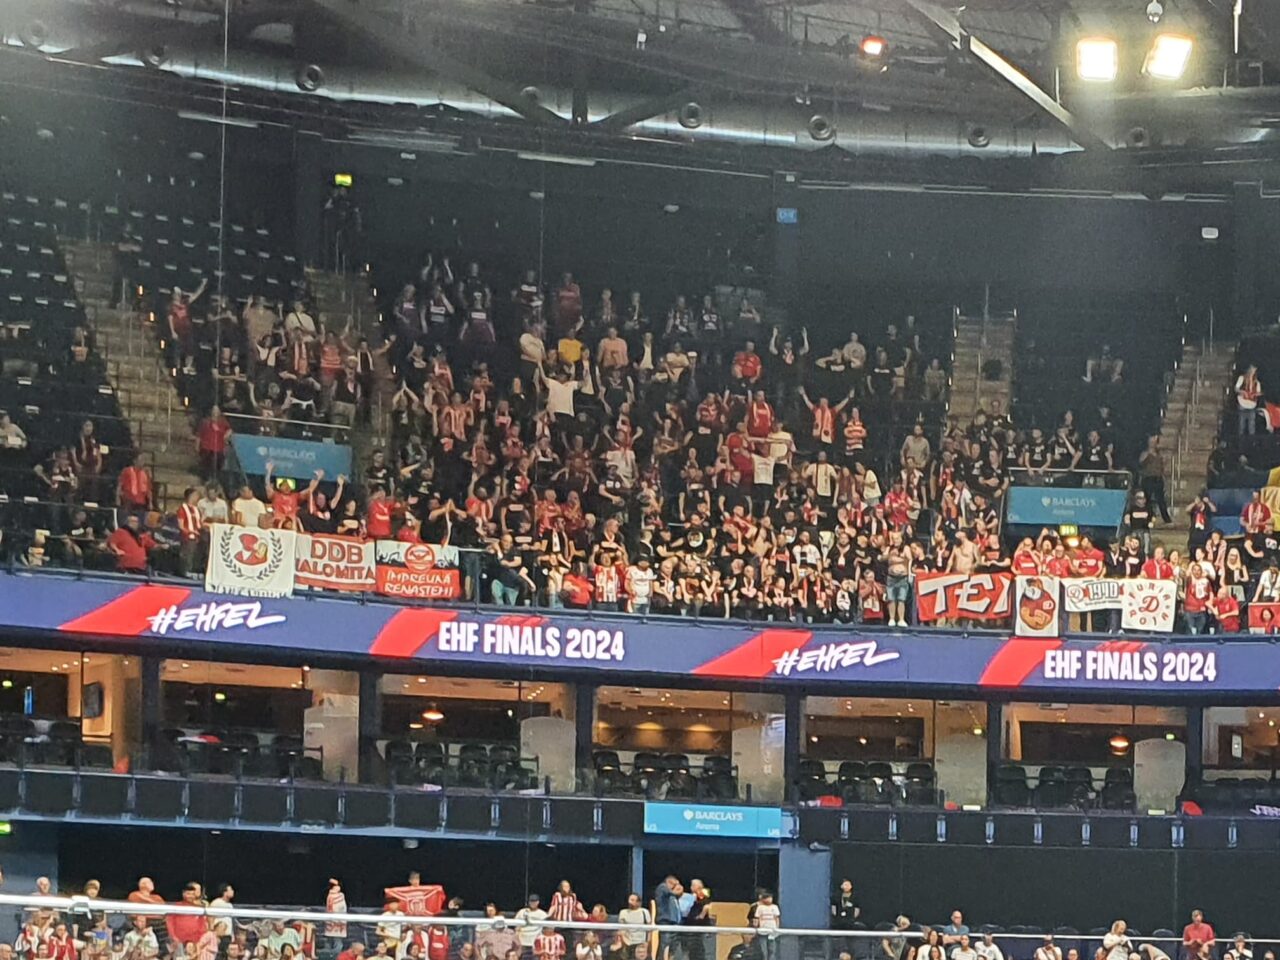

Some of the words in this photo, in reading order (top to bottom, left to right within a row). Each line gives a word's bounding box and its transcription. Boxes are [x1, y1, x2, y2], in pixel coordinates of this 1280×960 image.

[1052, 497, 1096, 507] BARCLAYS
[311, 540, 364, 564] DDB
[147, 602, 286, 634] #EHFEL
[438, 621, 479, 652] EHF
[483, 624, 561, 657] FINALS
[565, 628, 625, 661] 2024
[772, 641, 900, 675] #EHFEL
[1044, 650, 1082, 679] EHF
[1086, 651, 1159, 682] FINALS
[1162, 651, 1216, 682] 2024
[695, 810, 743, 821] BARCLAYS
